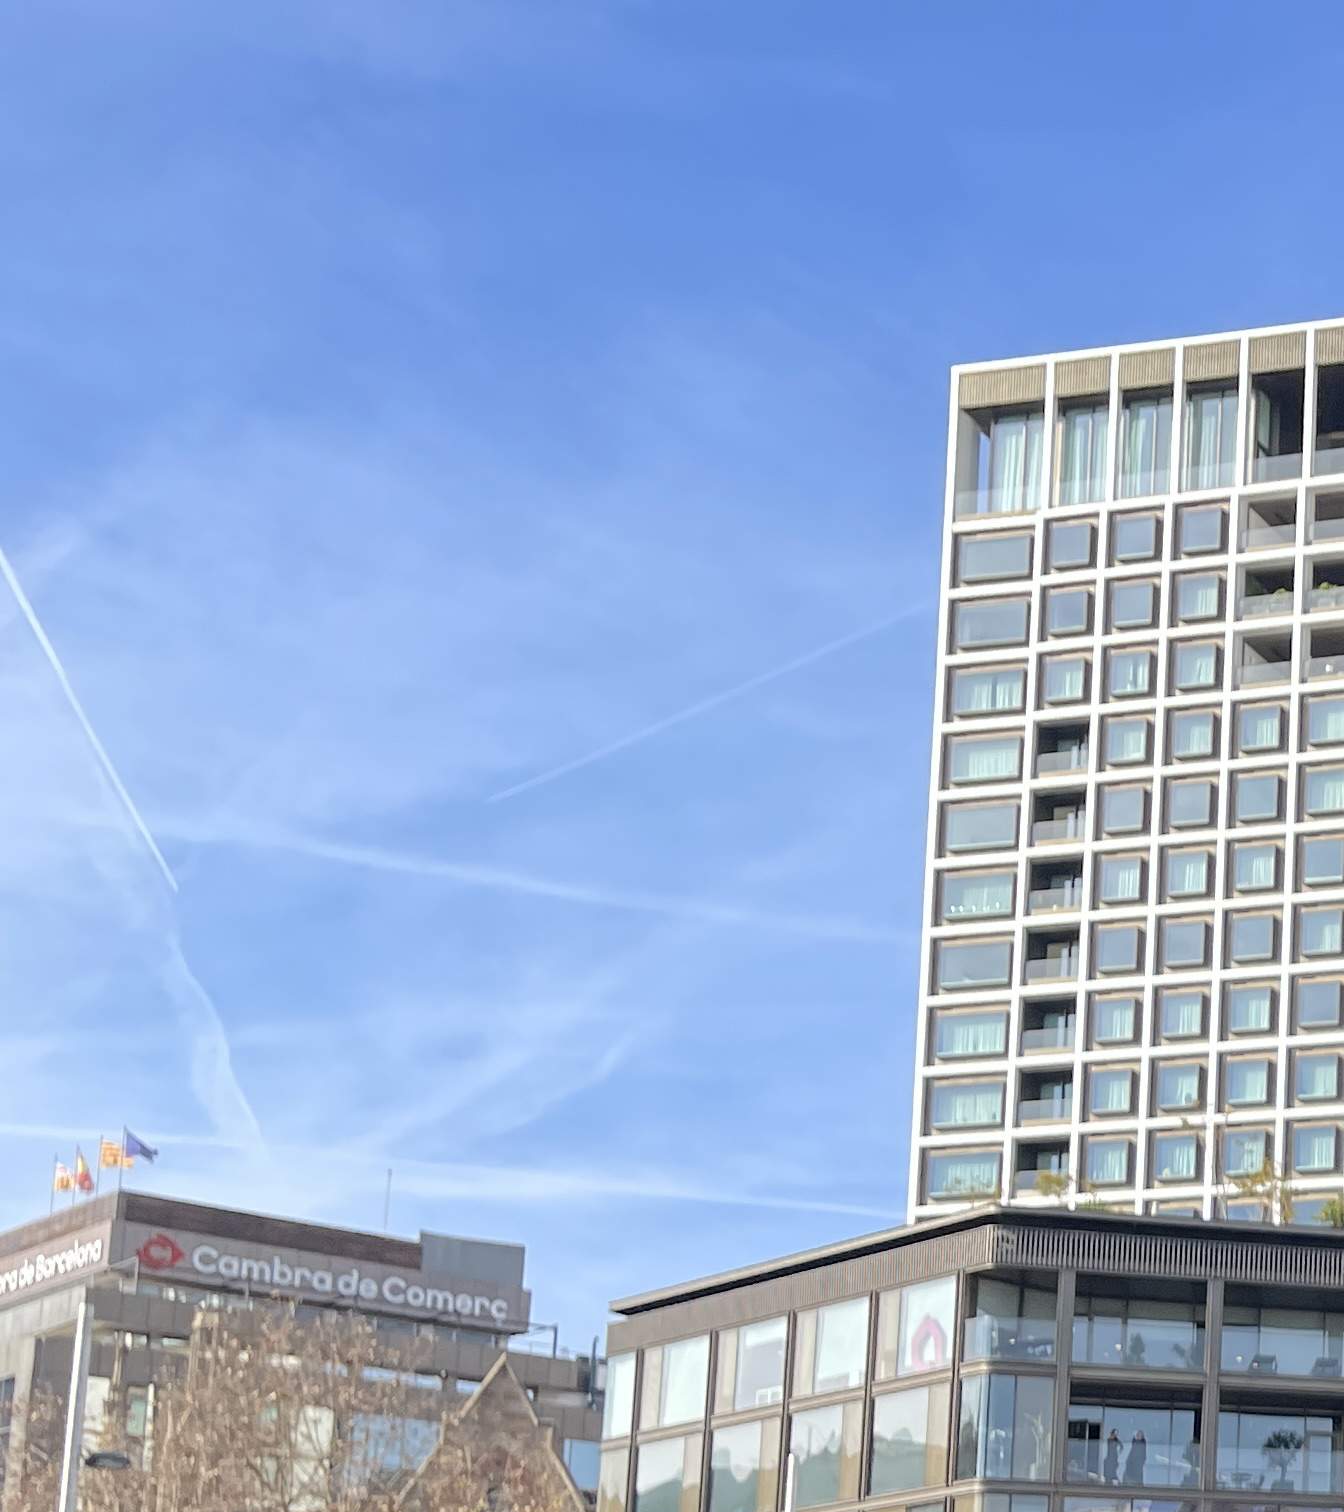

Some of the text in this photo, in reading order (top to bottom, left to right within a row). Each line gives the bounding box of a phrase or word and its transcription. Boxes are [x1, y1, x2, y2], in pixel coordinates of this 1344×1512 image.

[18, 1259, 35, 1289] de
[36, 1239, 102, 1282] Barcelona
[192, 1244, 509, 1327] Cambra de Comerç
